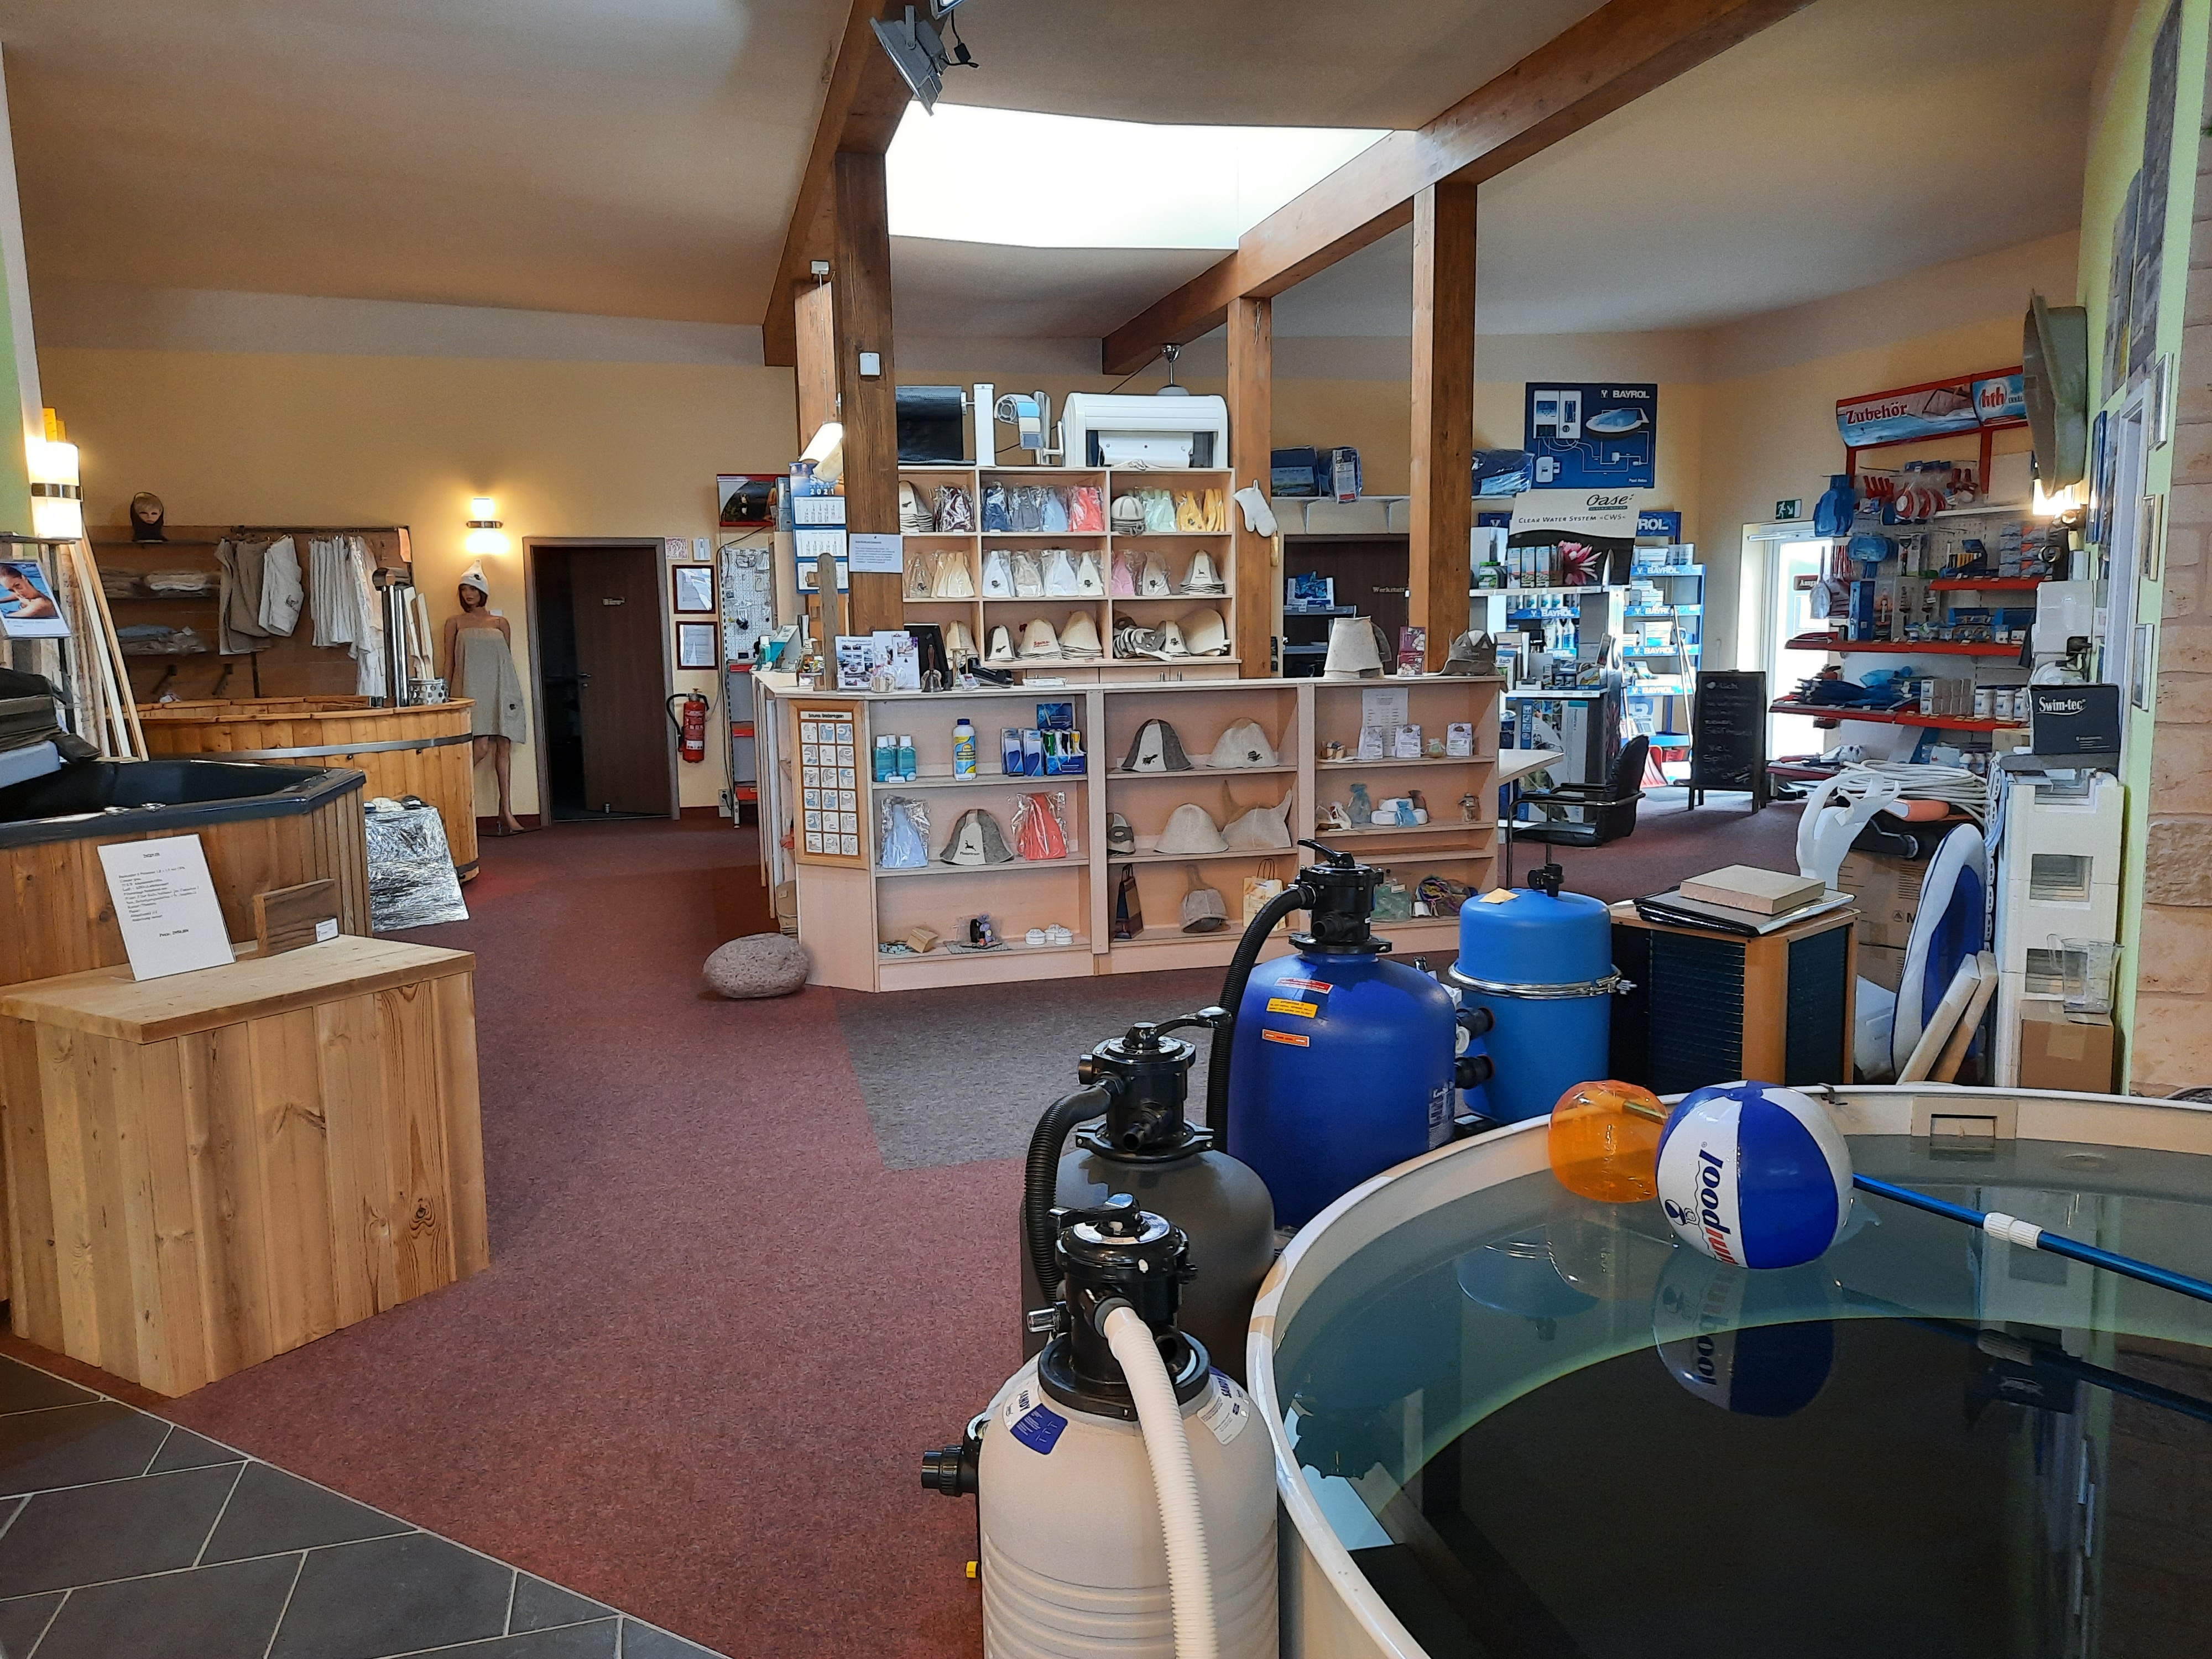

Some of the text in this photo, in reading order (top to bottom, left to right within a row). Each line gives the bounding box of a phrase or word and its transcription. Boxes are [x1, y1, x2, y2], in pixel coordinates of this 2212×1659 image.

[1613, 390, 1650, 399] BAYROL
[1846, 401, 1907, 425] Zubehör
[1587, 494, 1628, 507] Oase
[1638, 518, 1669, 530] ROL
